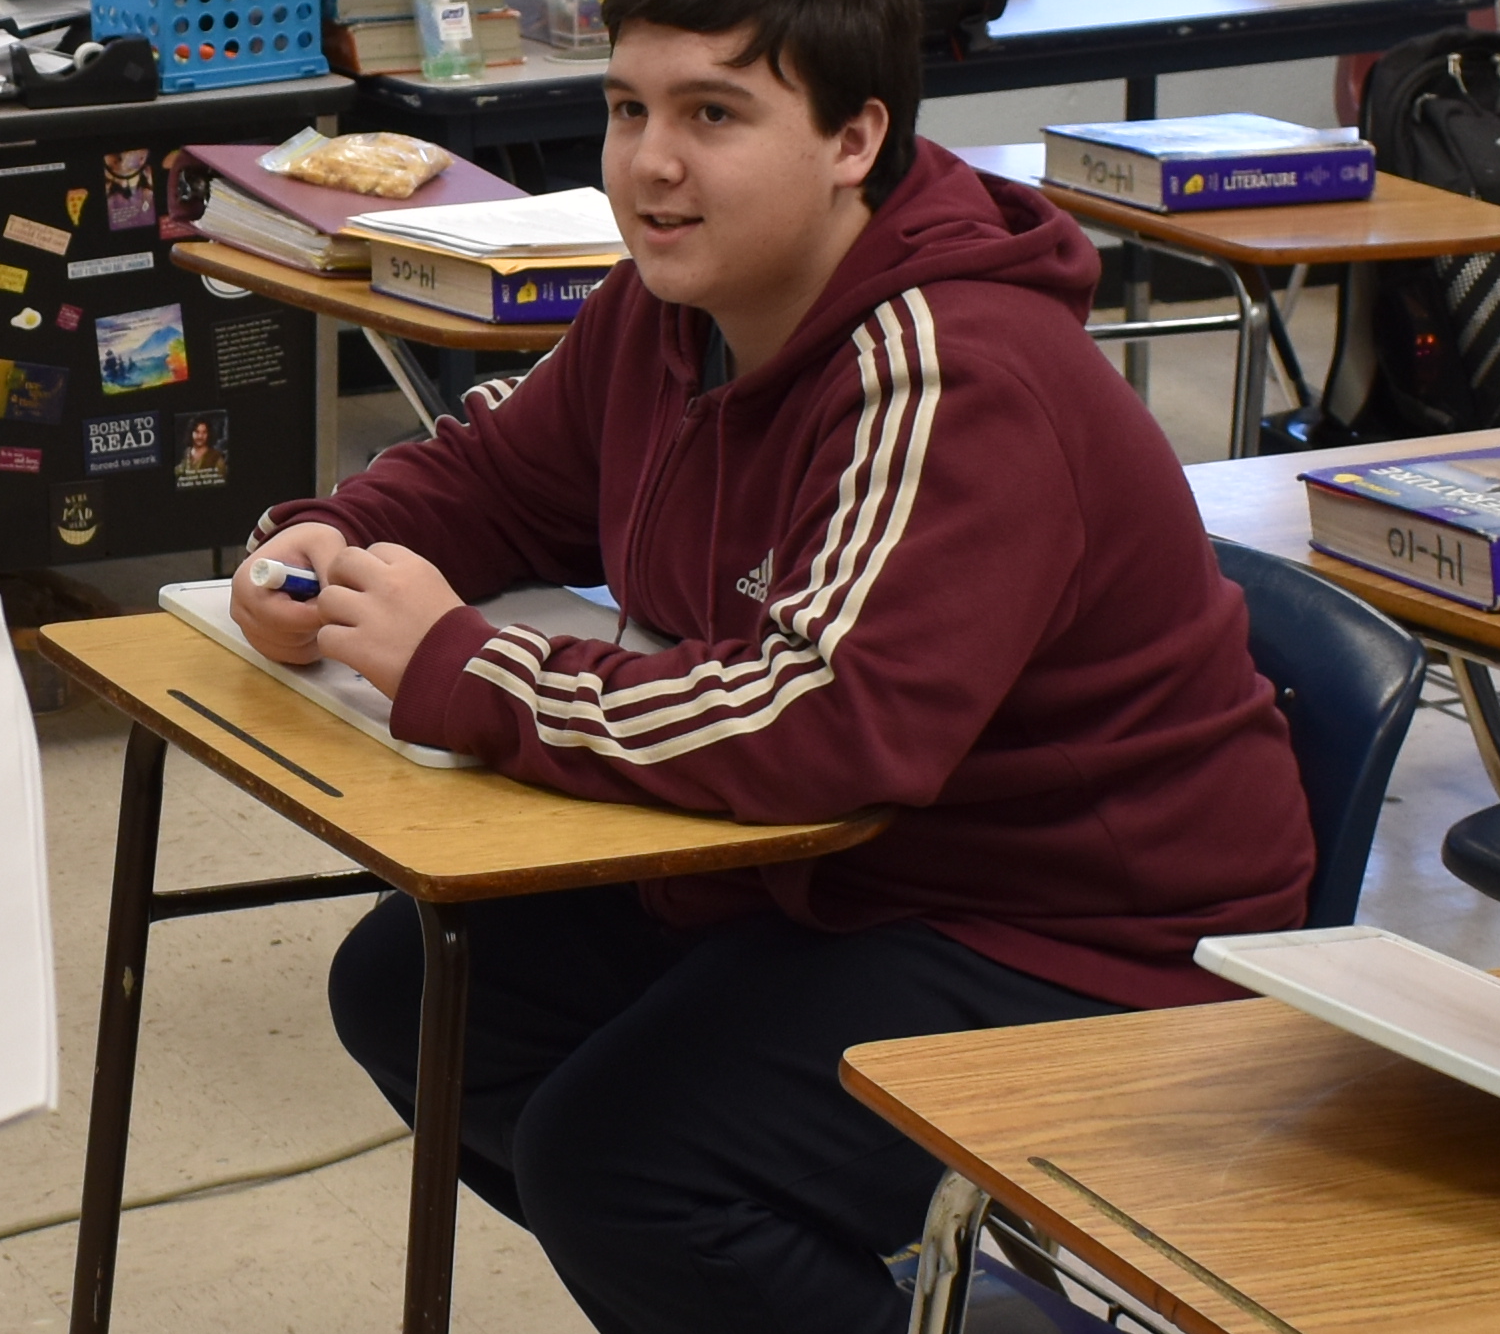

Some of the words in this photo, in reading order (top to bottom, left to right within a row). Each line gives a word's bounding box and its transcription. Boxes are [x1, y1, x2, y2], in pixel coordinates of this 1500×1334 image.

[1223, 171, 1298, 192] LITERATURE
[390, 256, 436, 291] 14-05
[89, 420, 131, 436] BORN
[136, 416, 154, 430] TO
[90, 430, 155, 454] READ
[89, 459, 120, 472] forced
[121, 459, 131, 468] to
[133, 454, 157, 467] work
[1387, 526, 1465, 586] 14-10
